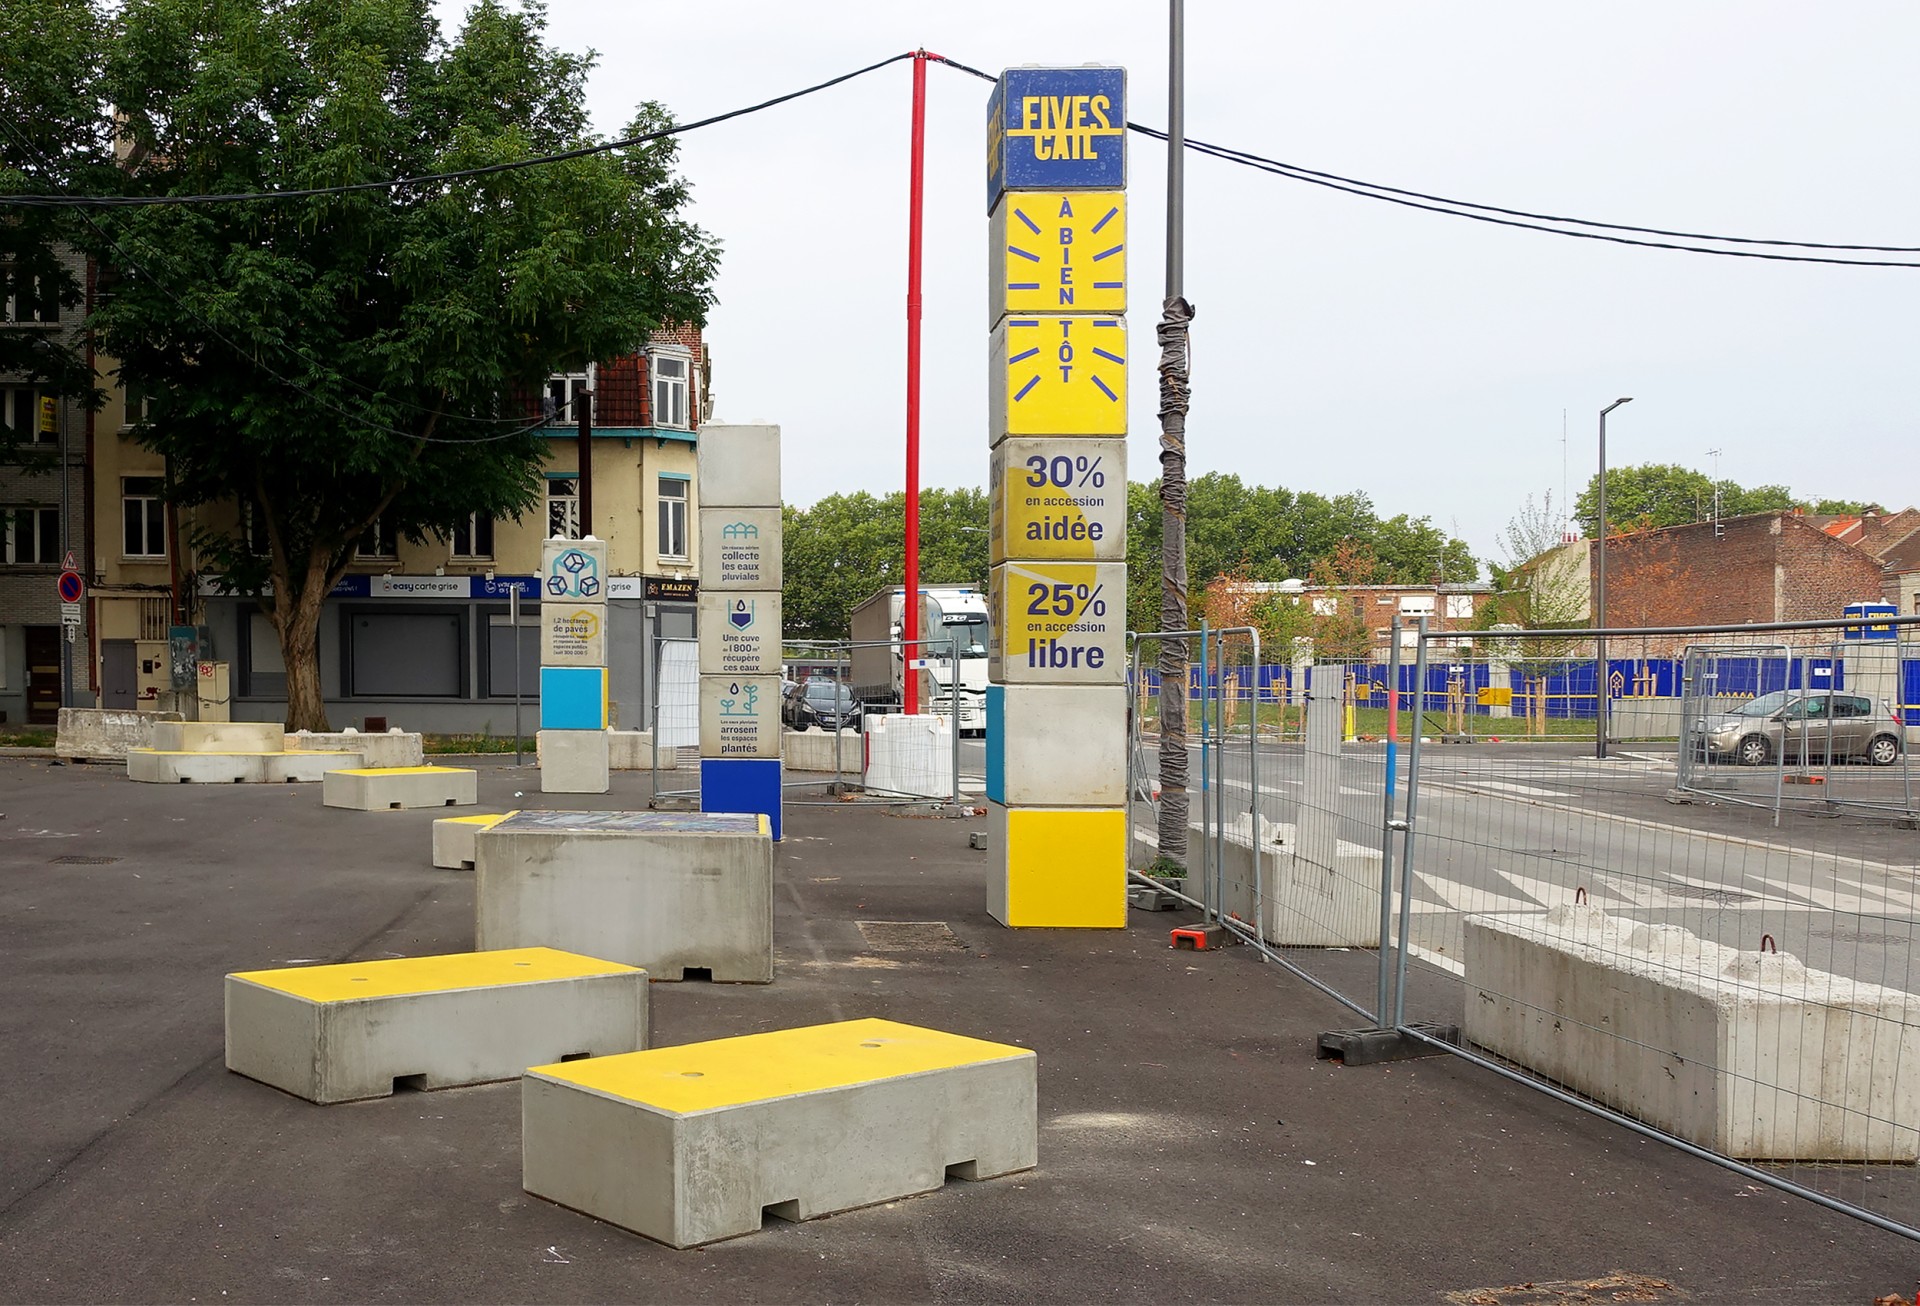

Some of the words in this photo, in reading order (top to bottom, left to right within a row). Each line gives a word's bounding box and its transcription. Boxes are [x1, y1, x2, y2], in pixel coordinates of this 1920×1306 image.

[1022, 94, 1111, 133] FIVES
[1034, 132, 1098, 161] CAIL
[1059, 197, 1074, 218] À
[1059, 227, 1074, 305] BIEN
[1059, 320, 1073, 383] TÔT
[1026, 455, 1105, 489] 30%
[1026, 497, 1041, 507] en
[1044, 496, 1104, 507] accession
[1026, 515, 1104, 541] aidée
[722, 551, 760, 560] collecte
[722, 562, 736, 571] les
[737, 563, 760, 571] eaux
[722, 573, 760, 582] pluviales
[392, 583, 414, 592] easy
[438, 583, 459, 591] grise
[610, 583, 632, 592] grise
[1027, 583, 1106, 617] 25%
[553, 624, 563, 633] de
[564, 624, 588, 634] pavés
[1027, 623, 1042, 632] en
[1045, 622, 1106, 632] accession
[722, 634, 739, 642] Une
[722, 653, 760, 663] récupère
[1028, 638, 1105, 669] libre
[720, 726, 758, 734] arrosent
[721, 743, 758, 754] plantés
